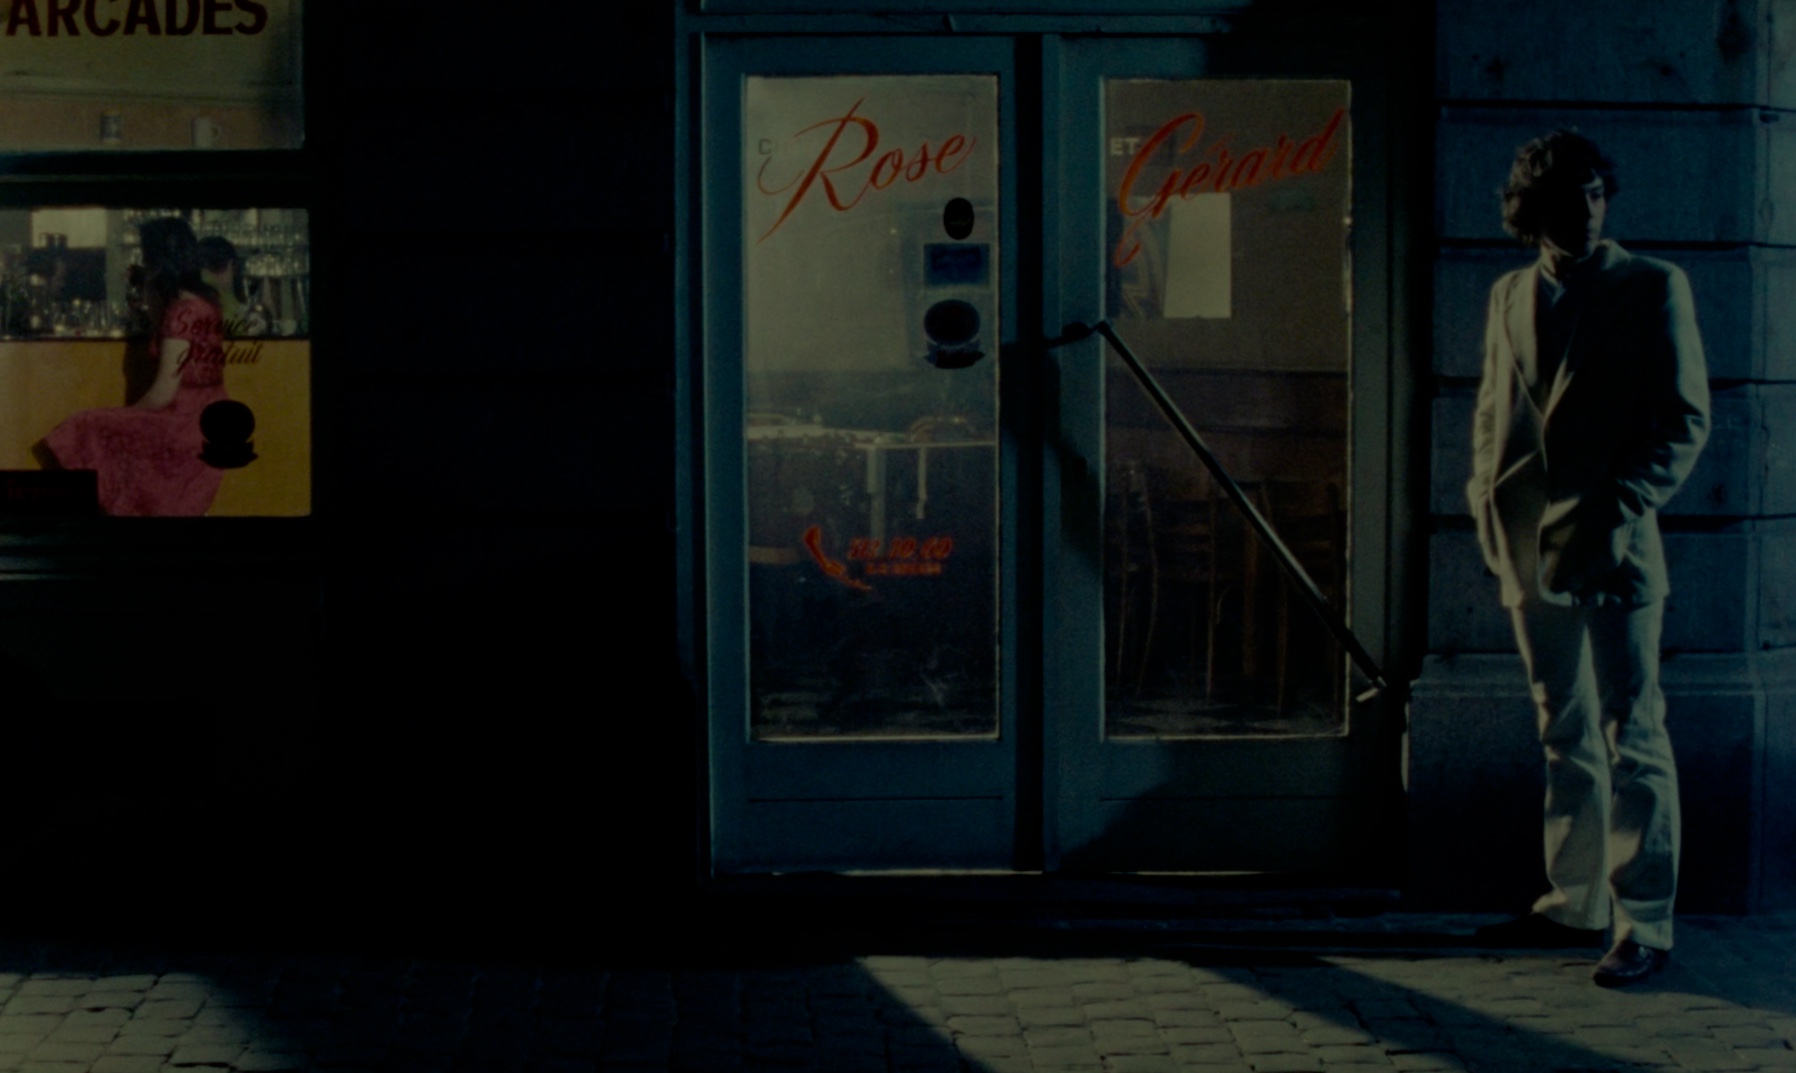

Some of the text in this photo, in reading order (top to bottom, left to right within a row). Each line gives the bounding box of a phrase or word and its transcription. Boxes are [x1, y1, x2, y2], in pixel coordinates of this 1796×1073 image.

[6, 0, 268, 36] ARCADES
[758, 97, 1345, 269] Rose ET Gérard
